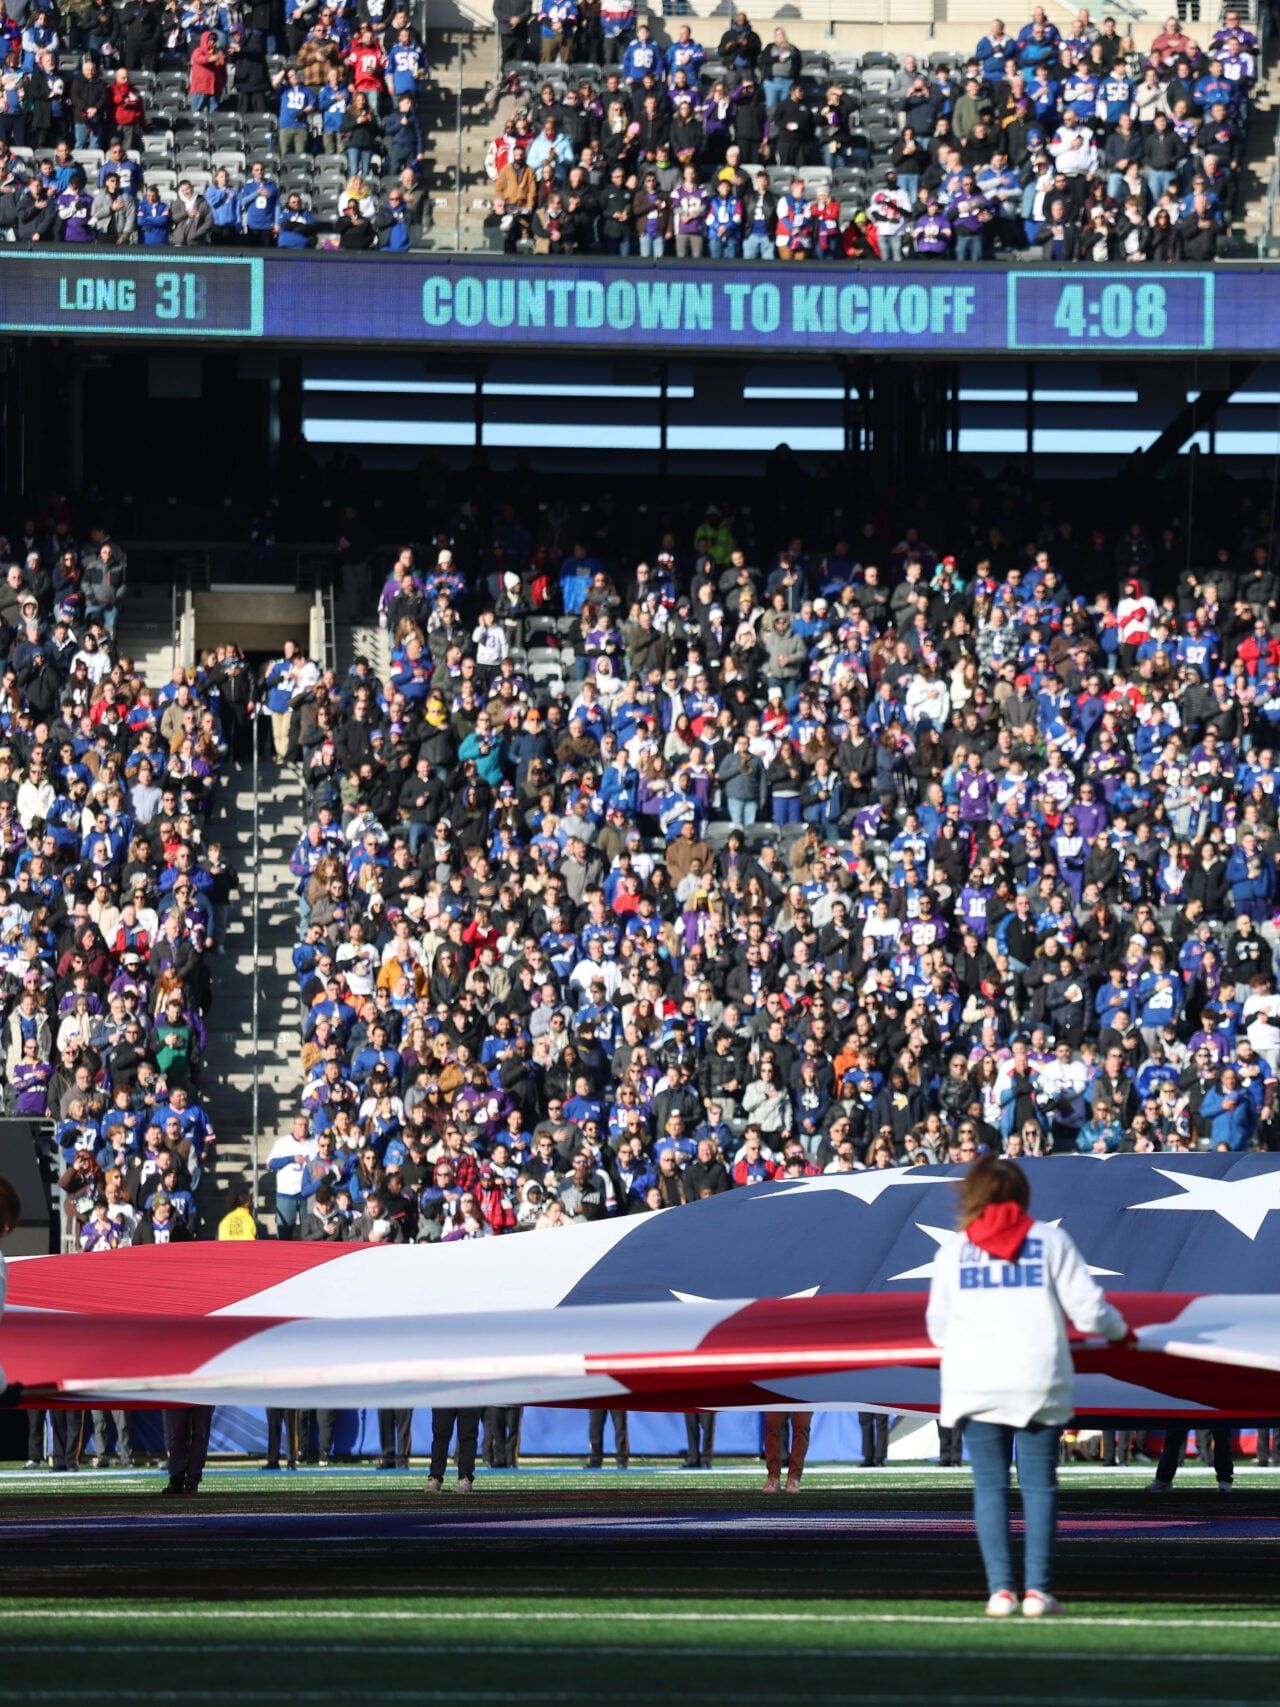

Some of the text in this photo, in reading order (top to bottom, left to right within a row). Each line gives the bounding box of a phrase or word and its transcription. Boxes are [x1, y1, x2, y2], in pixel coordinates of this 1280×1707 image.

[58, 277, 137, 311] LONG
[421, 275, 976, 335] COUNTDOWN TO KICKOFF
[1053, 282, 1169, 340] 4:08
[959, 1264, 1044, 1290] BLUE
